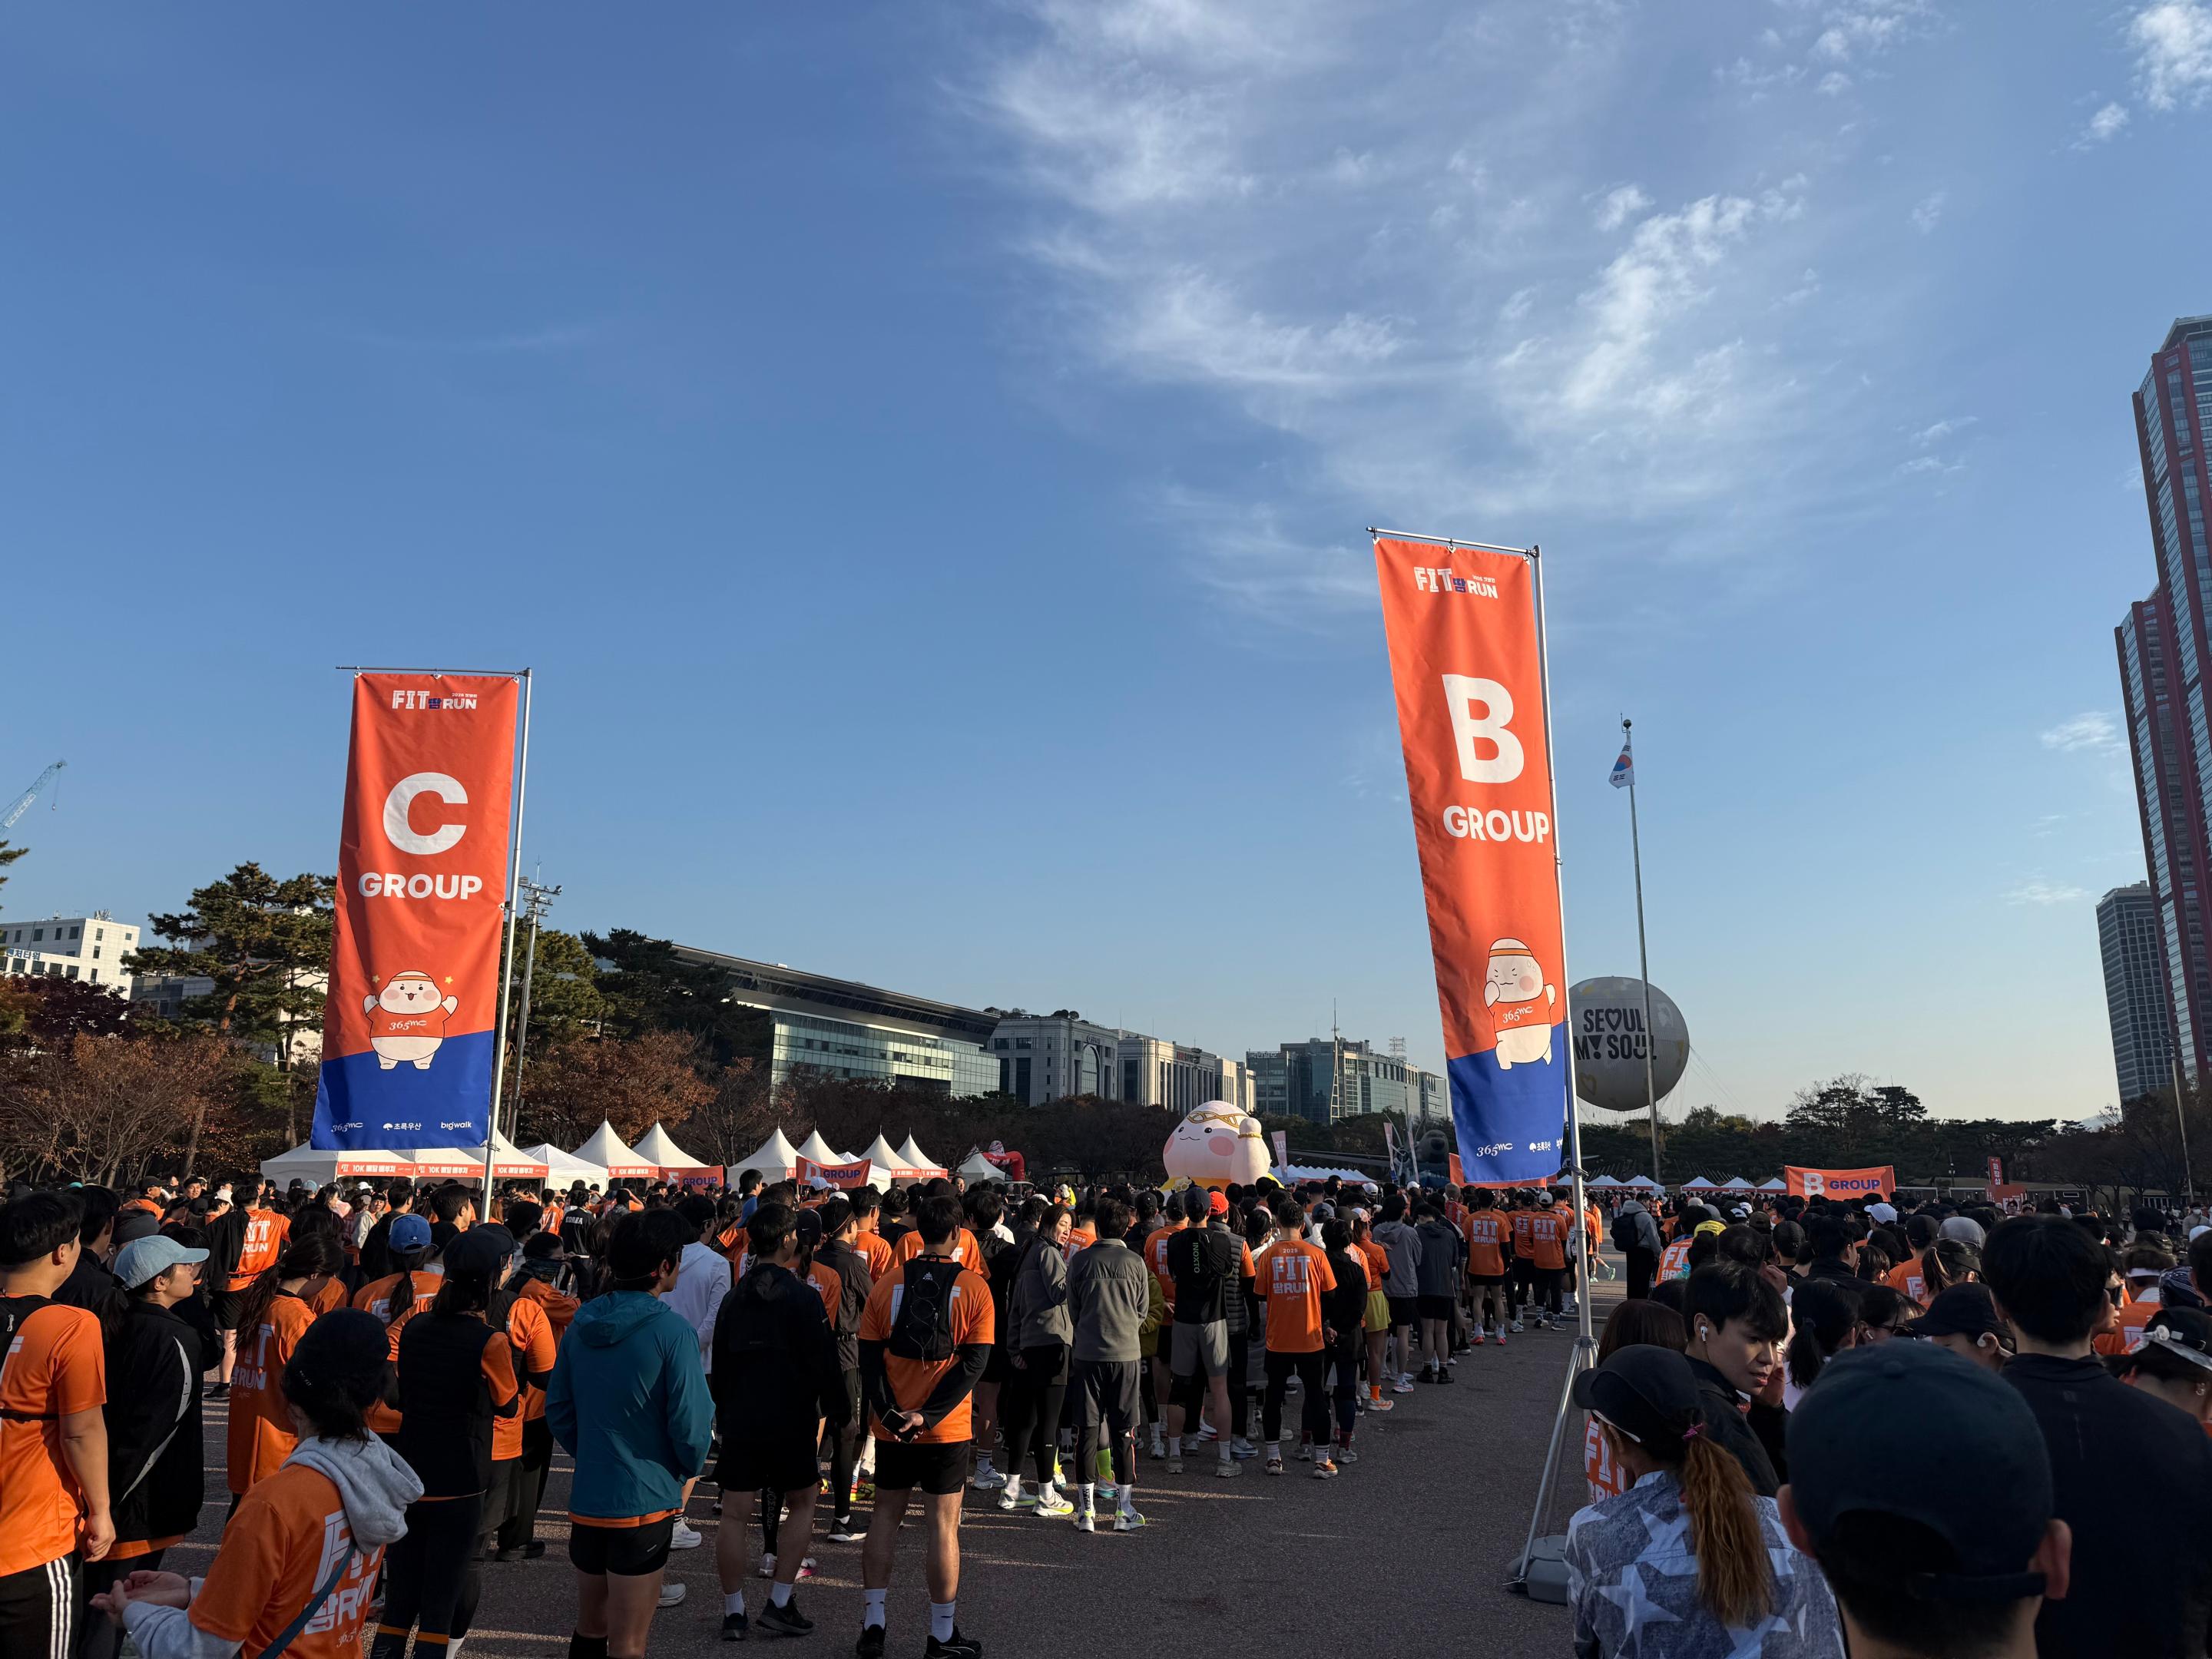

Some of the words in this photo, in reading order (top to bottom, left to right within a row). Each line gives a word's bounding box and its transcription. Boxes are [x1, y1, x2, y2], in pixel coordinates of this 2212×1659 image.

[1442, 674, 1525, 783] B
[382, 772, 469, 855] C
[1443, 805, 1549, 843] GROUP
[358, 873, 482, 900] GROUP
[1502, 1005, 1533, 1024] 365mc
[389, 1020, 427, 1031] 365mc
[331, 1122, 363, 1132] 365mc
[441, 1121, 472, 1130] bigwalk
[1476, 1143, 1512, 1157] 365mc
[683, 1177, 717, 1187] GROUP
[823, 1170, 861, 1179] GROUP
[1803, 1173, 1825, 1195] B
[1829, 1179, 1880, 1190] GROUP
[247, 1220, 271, 1242] IT
[1473, 1220, 1498, 1236] FIT
[1534, 1219, 1556, 1233] FIT
[1663, 1247, 1689, 1268] FI
[1271, 1256, 1311, 1281] FIT
